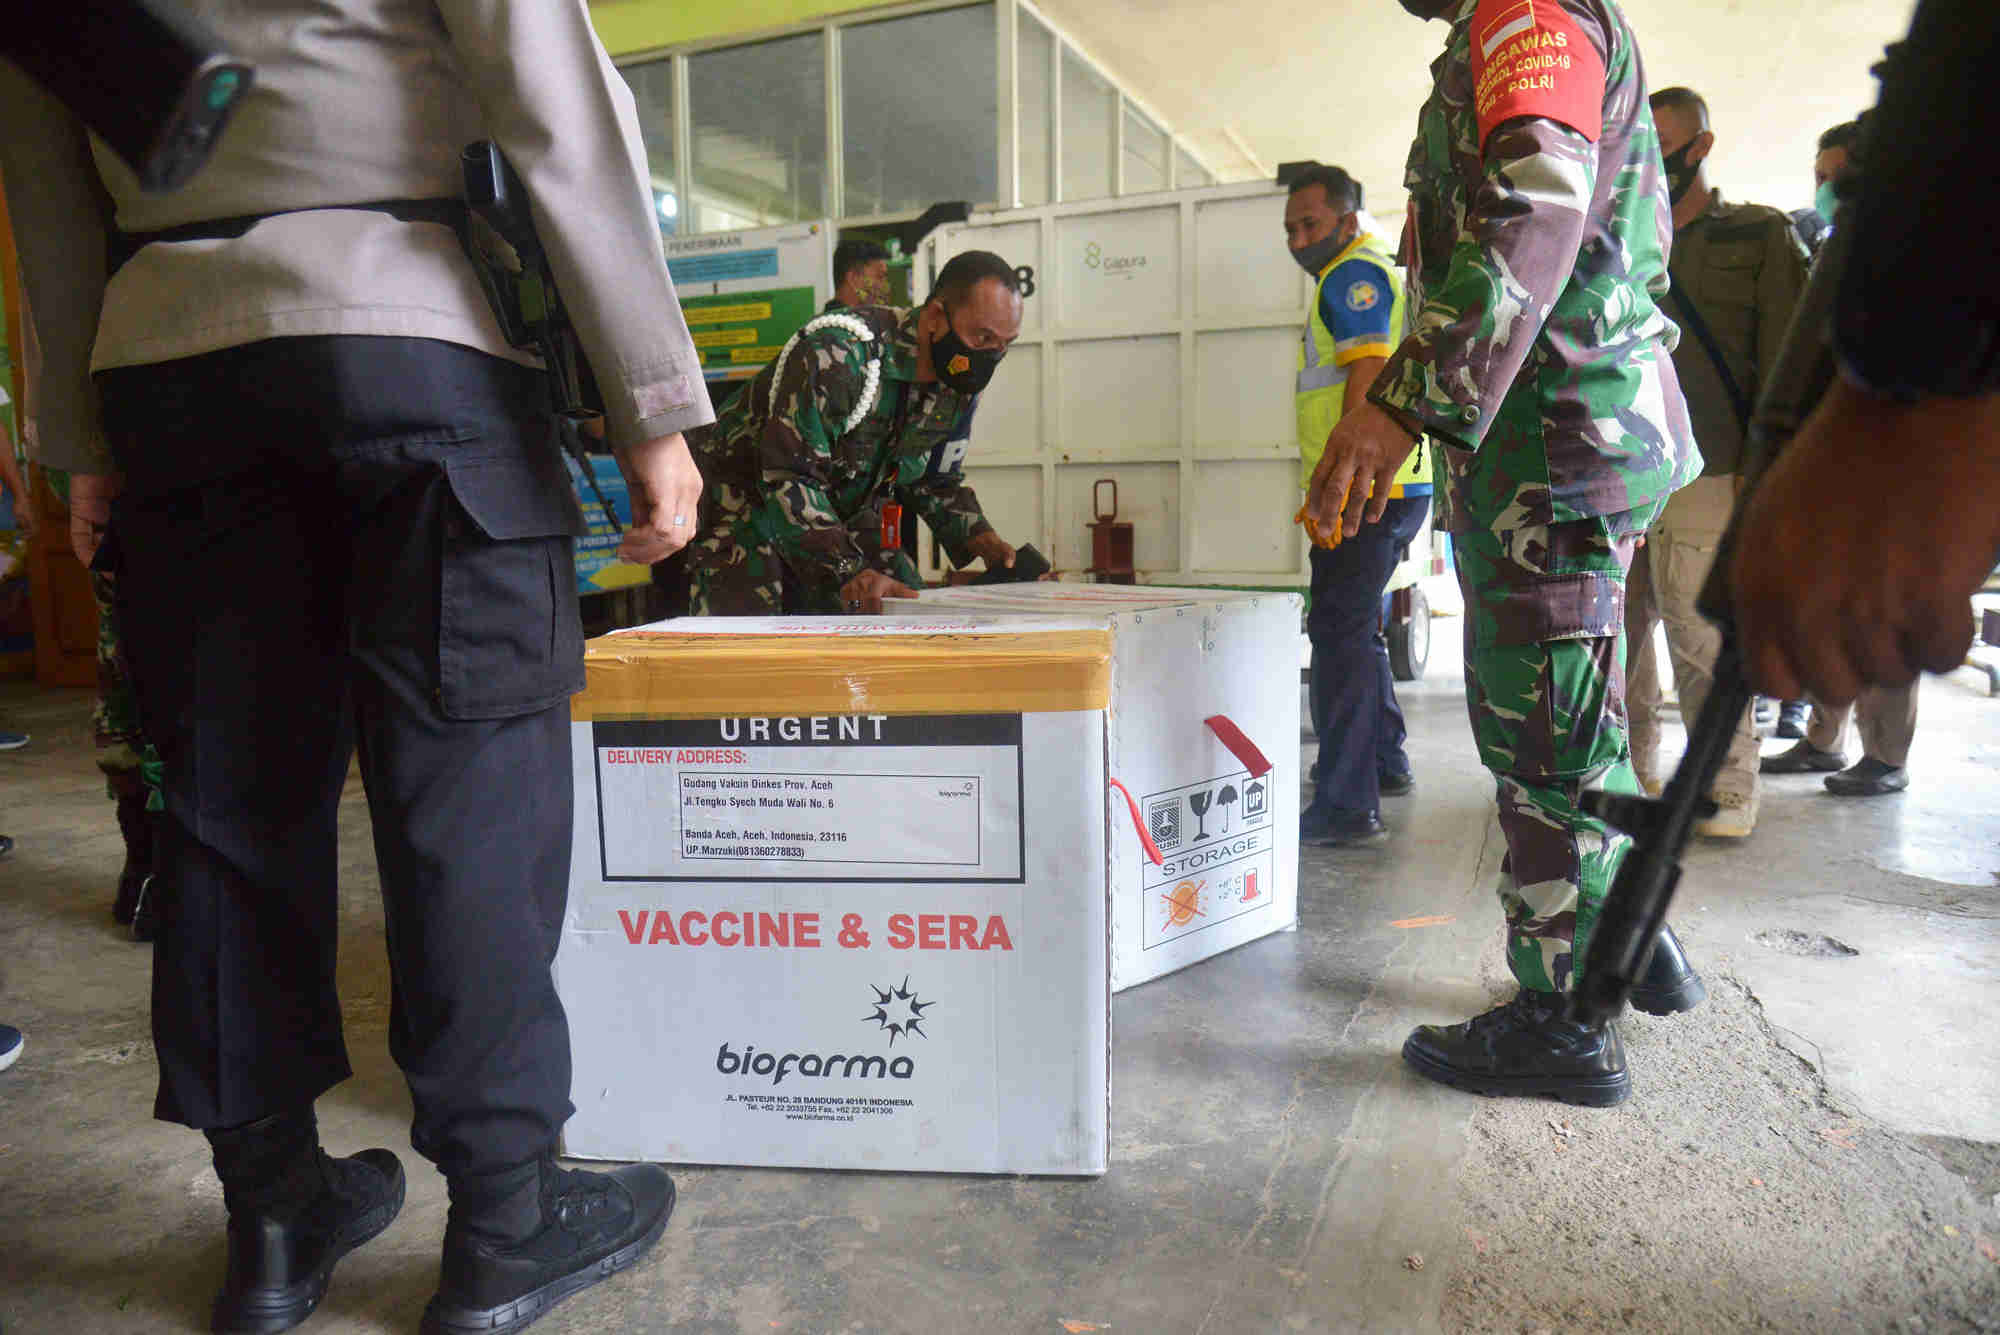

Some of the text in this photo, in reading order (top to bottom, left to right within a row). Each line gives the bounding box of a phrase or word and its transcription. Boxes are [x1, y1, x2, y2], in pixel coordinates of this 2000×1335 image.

[1516, 55, 1570, 72] COVID-19
[1508, 74, 1554, 93] POLRI
[719, 716, 888, 741] URGENT
[607, 750, 747, 764] DELIVERY ADDRESS:
[683, 778, 717, 791] Gudang
[720, 779, 749, 789] Vaksin
[752, 779, 782, 790] Dinkes
[811, 780, 833, 791] Aceh
[729, 797, 756, 809] Syech
[759, 798, 784, 808] Muda
[787, 798, 807, 808] Wali
[809, 799, 825, 808] No.
[828, 799, 834, 808] 6
[1248, 793, 1262, 809] UP
[685, 829, 712, 840] Banda
[1162, 837, 1258, 876] STORAGE
[617, 909, 1013, 951] VACCINE & SERA
[716, 1042, 914, 1086] biofarma
